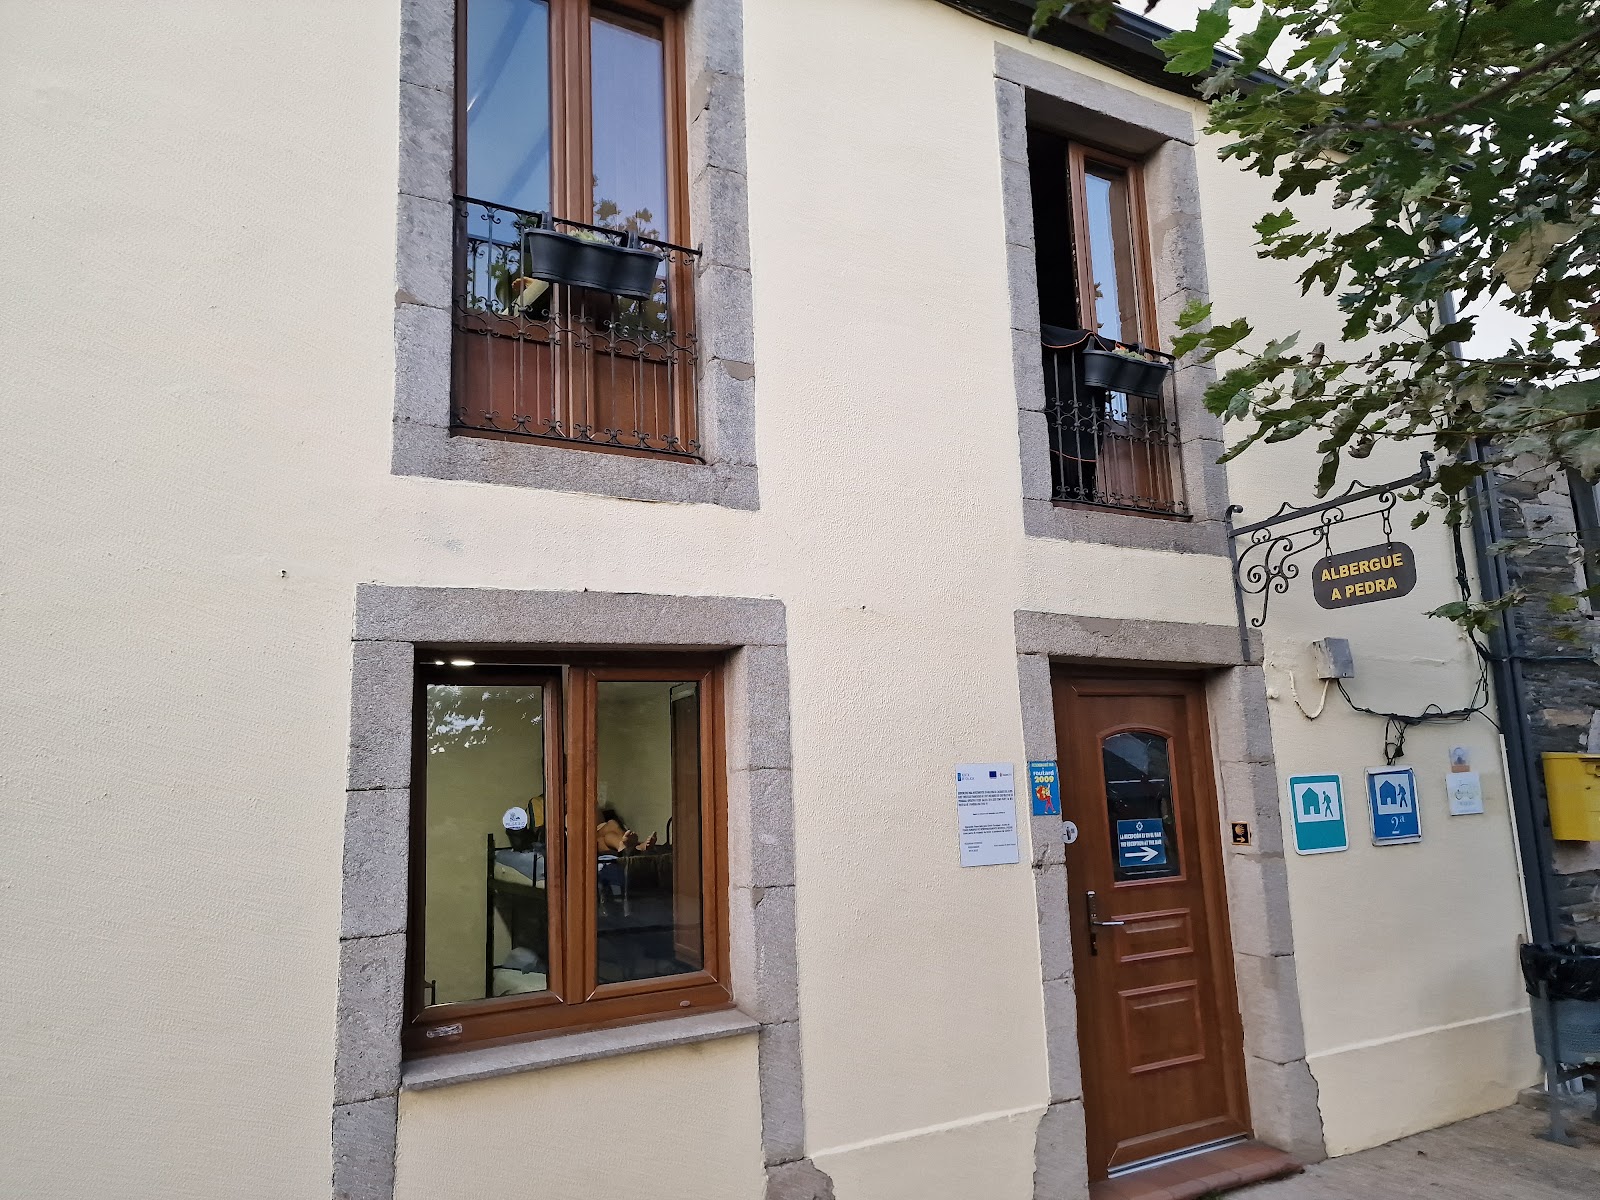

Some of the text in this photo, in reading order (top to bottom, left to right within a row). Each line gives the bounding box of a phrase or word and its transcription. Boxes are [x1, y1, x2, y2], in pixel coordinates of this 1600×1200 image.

[1321, 553, 1404, 581] ALBERGUE
[1331, 577, 1398, 601] A PEDRA
